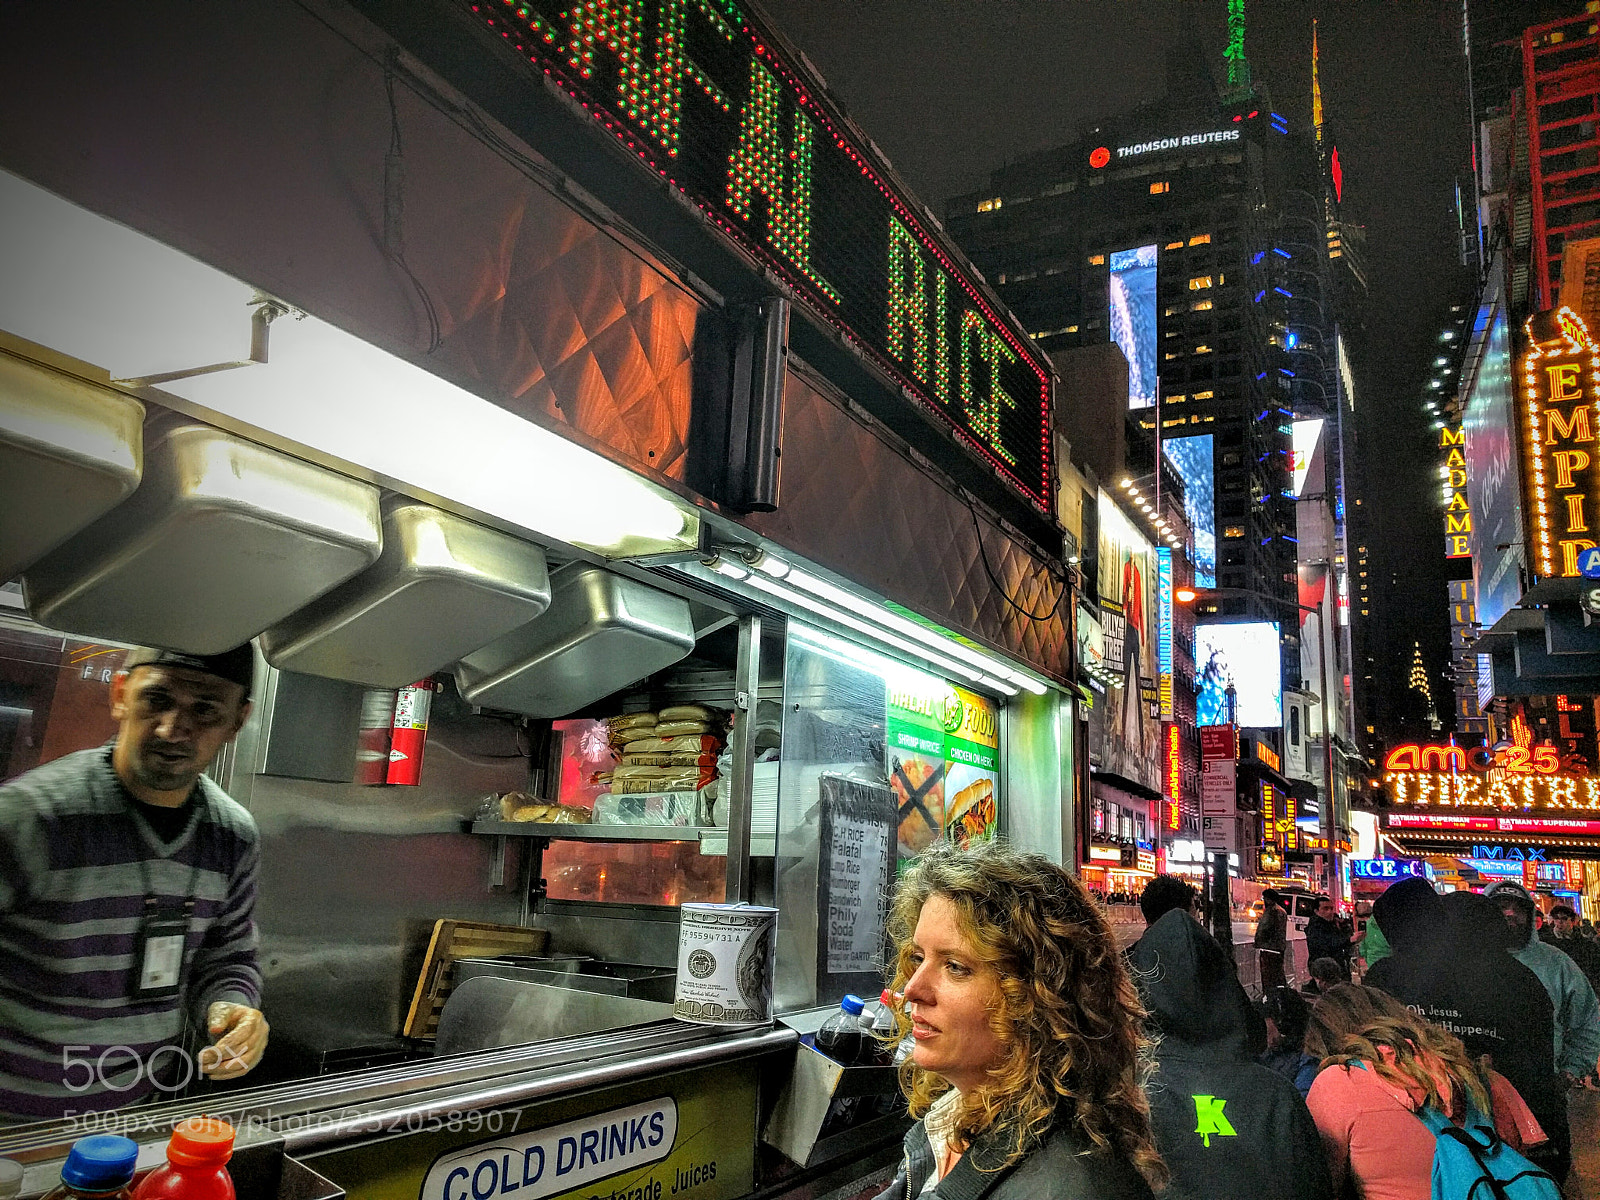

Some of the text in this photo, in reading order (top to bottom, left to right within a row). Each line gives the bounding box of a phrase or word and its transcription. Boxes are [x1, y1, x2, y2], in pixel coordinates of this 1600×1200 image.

[1117, 130, 1240, 158] THOMSON REUTERS
[887, 213, 1017, 467] RICE
[1562, 317, 1586, 347] amc
[1441, 427, 1472, 556] MADAME
[1101, 610, 1119, 640] BILLY
[1101, 635, 1124, 662] STREET
[964, 702, 996, 738] FOOD
[897, 733, 919, 748] SHRIMP
[950, 747, 973, 762] CHICKEN
[973, 753, 980, 764] ON
[1505, 745, 1560, 773] 25
[1204, 762, 1210, 772] 3
[1263, 785, 1274, 839] NEW VICTORY
[1204, 818, 1210, 829] 5
[1499, 818, 1532, 826] BATMAN
[1542, 820, 1588, 828] SUPERMAN
[847, 829, 864, 842] RICE
[832, 840, 862, 859] Falafal
[1472, 845, 1547, 862] IMAX
[846, 860, 861, 875] Rice
[829, 907, 858, 925] Phily
[831, 921, 854, 937] Soda
[829, 937, 854, 951] Water
[1406, 1004, 1426, 1016] Oh
[443, 1110, 665, 1200] COLD DRINKS
[671, 1161, 717, 1195] Juices
